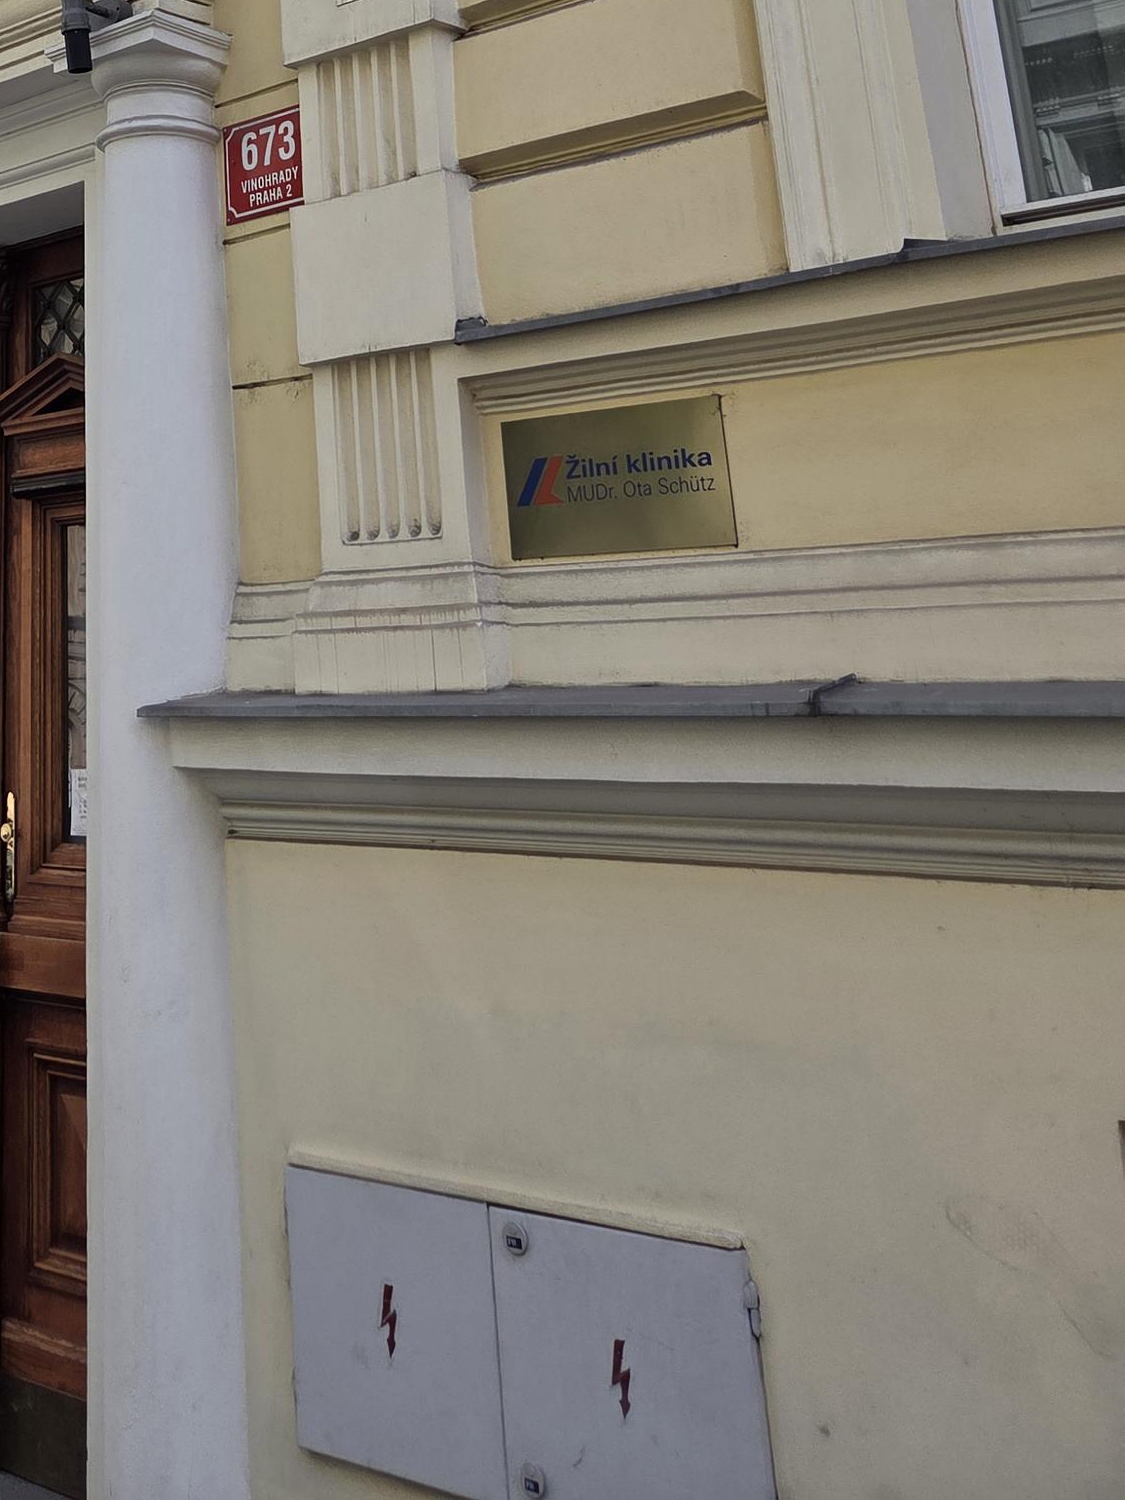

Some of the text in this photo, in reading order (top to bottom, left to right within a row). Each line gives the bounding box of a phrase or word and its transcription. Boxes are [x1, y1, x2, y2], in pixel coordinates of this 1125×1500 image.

[241, 120, 296, 171] 673
[241, 166, 299, 194] VINOHRADY
[249, 184, 293, 207] PRAHA 2
[565, 448, 713, 480] Žilní klinika
[567, 475, 716, 503] MUDr. Ota Schütz
